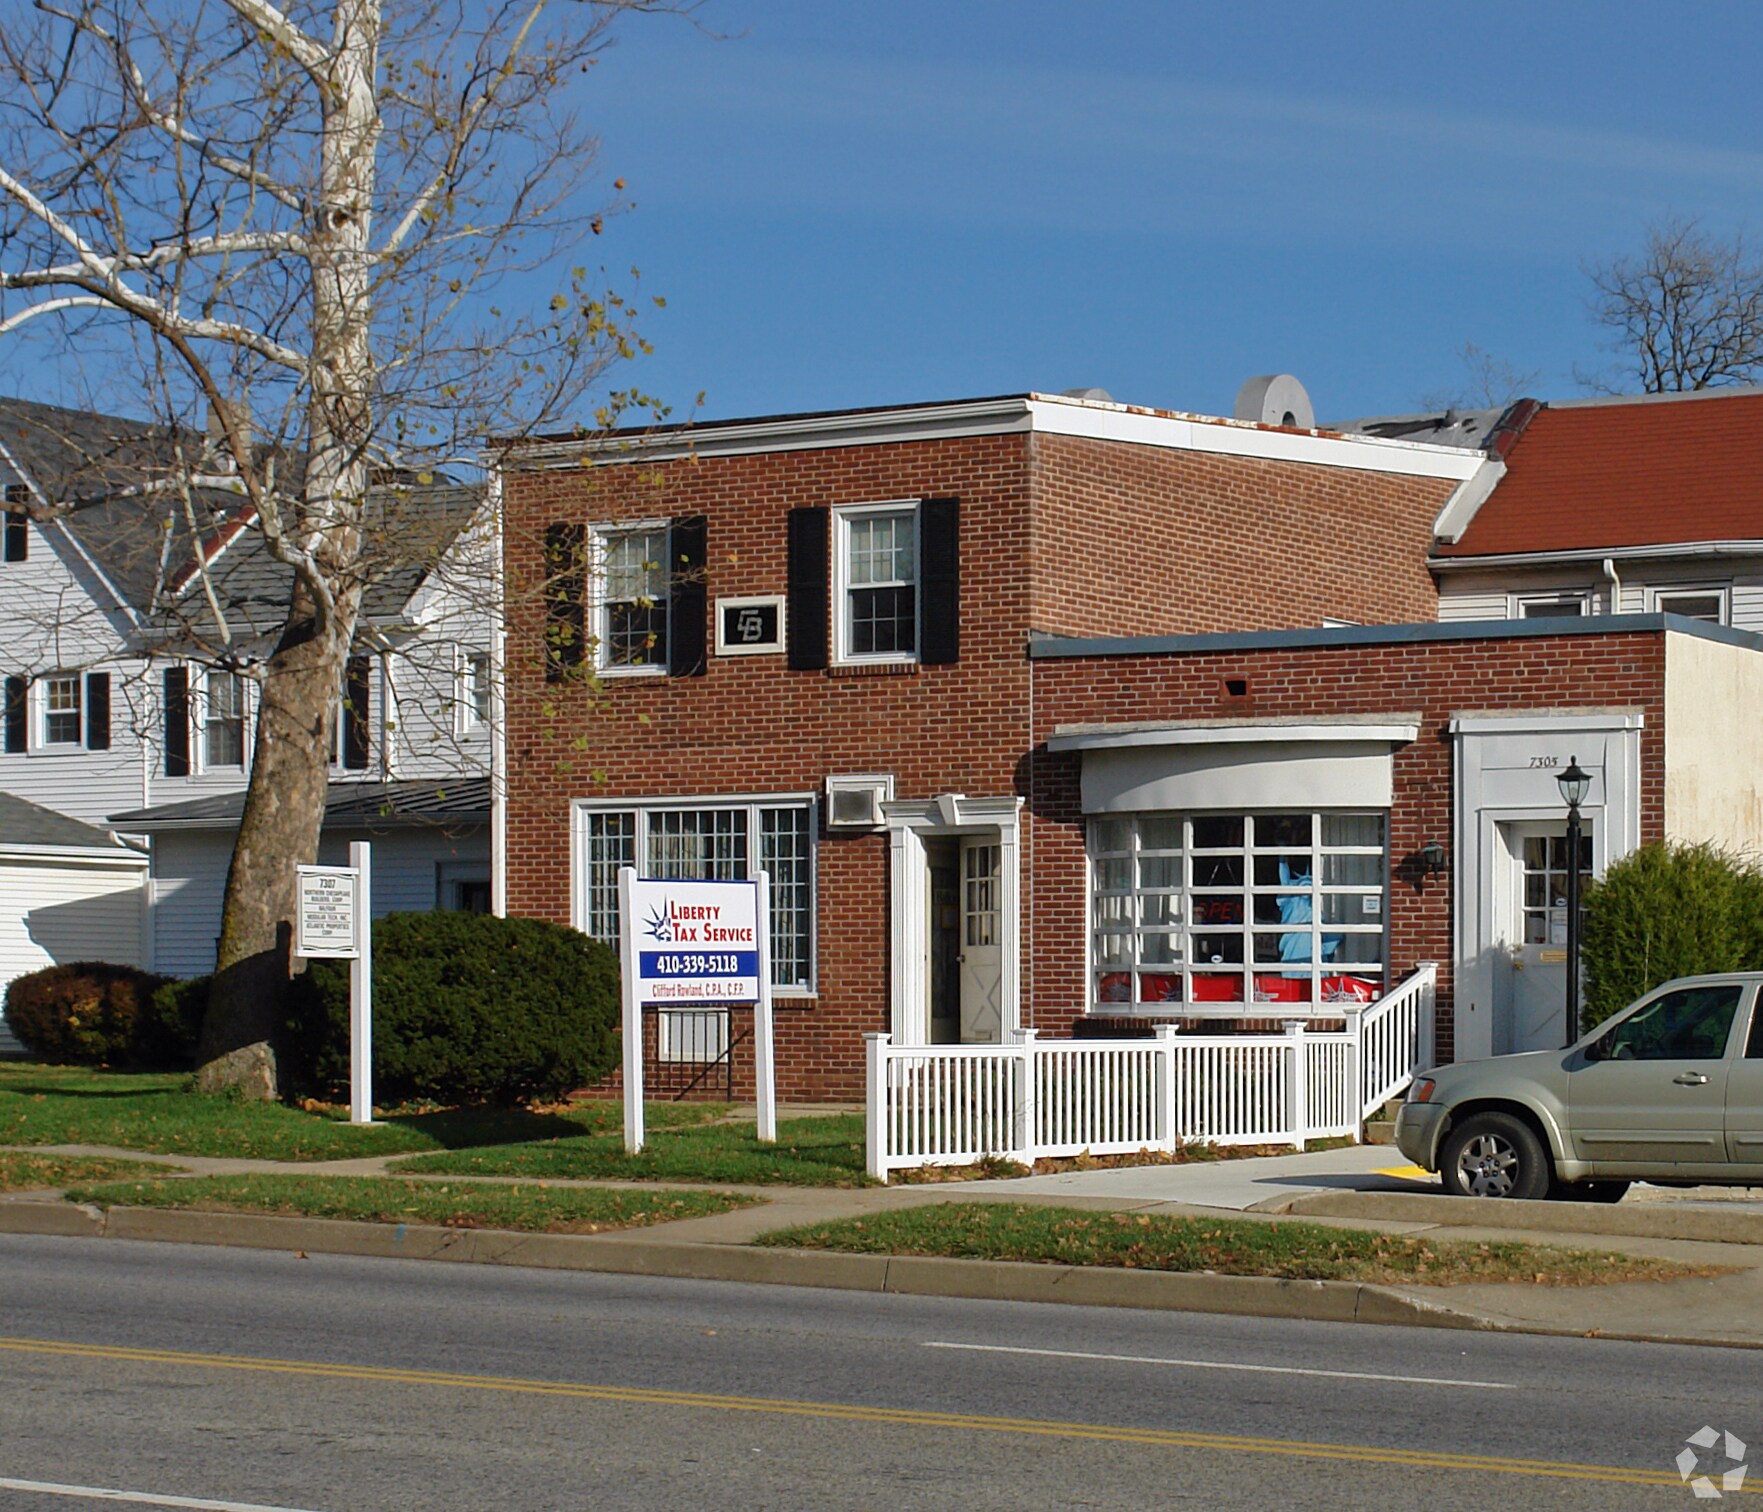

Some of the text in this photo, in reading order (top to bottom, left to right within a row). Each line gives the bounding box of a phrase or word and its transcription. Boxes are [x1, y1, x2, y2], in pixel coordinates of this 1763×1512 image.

[1530, 756, 1558, 768] 7305
[320, 879, 336, 888] 7307
[671, 900, 721, 920] LIBERTY
[672, 922, 753, 942] TAX SERVICE
[657, 956, 738, 974] 410-339-5118
[652, 983, 676, 998] Clifford
